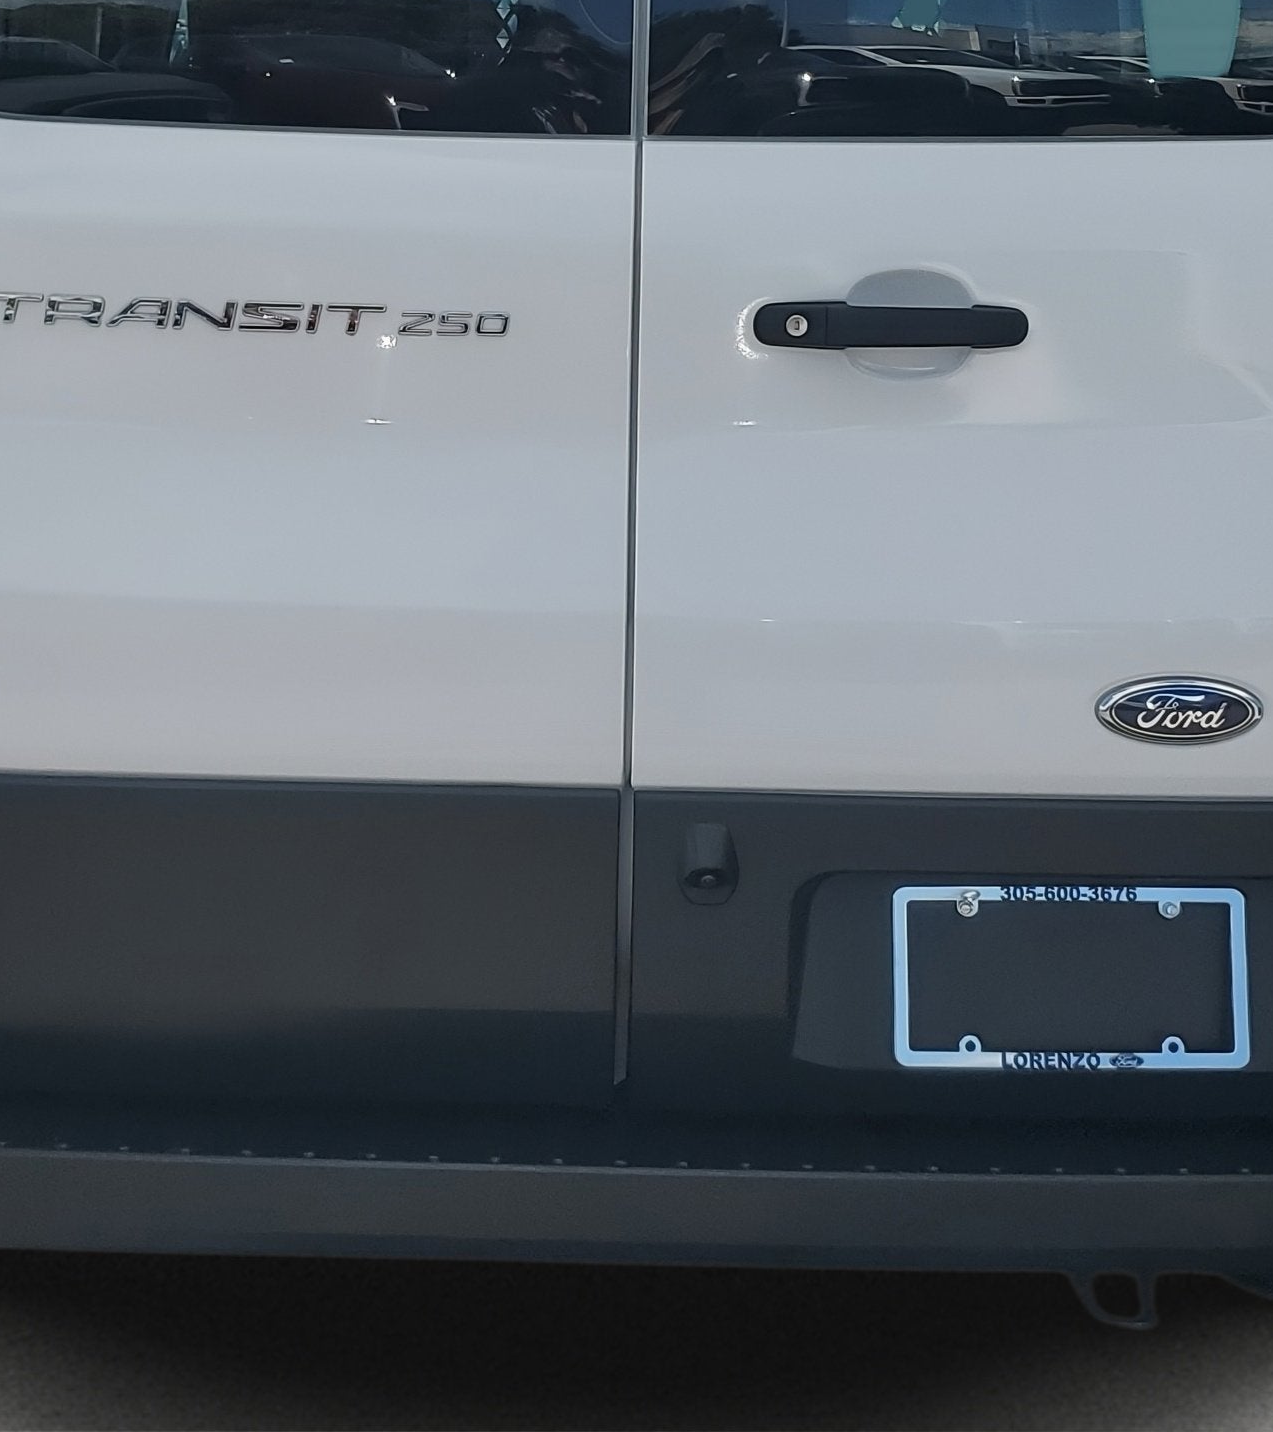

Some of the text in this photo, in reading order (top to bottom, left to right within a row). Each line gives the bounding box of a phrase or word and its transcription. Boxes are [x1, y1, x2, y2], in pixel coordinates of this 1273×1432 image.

[398, 311, 510, 337] 250
[1136, 693, 1228, 729] Ford
[1000, 886, 1138, 902] 305-600-3676
[1001, 1052, 1101, 1070] LORENZO
